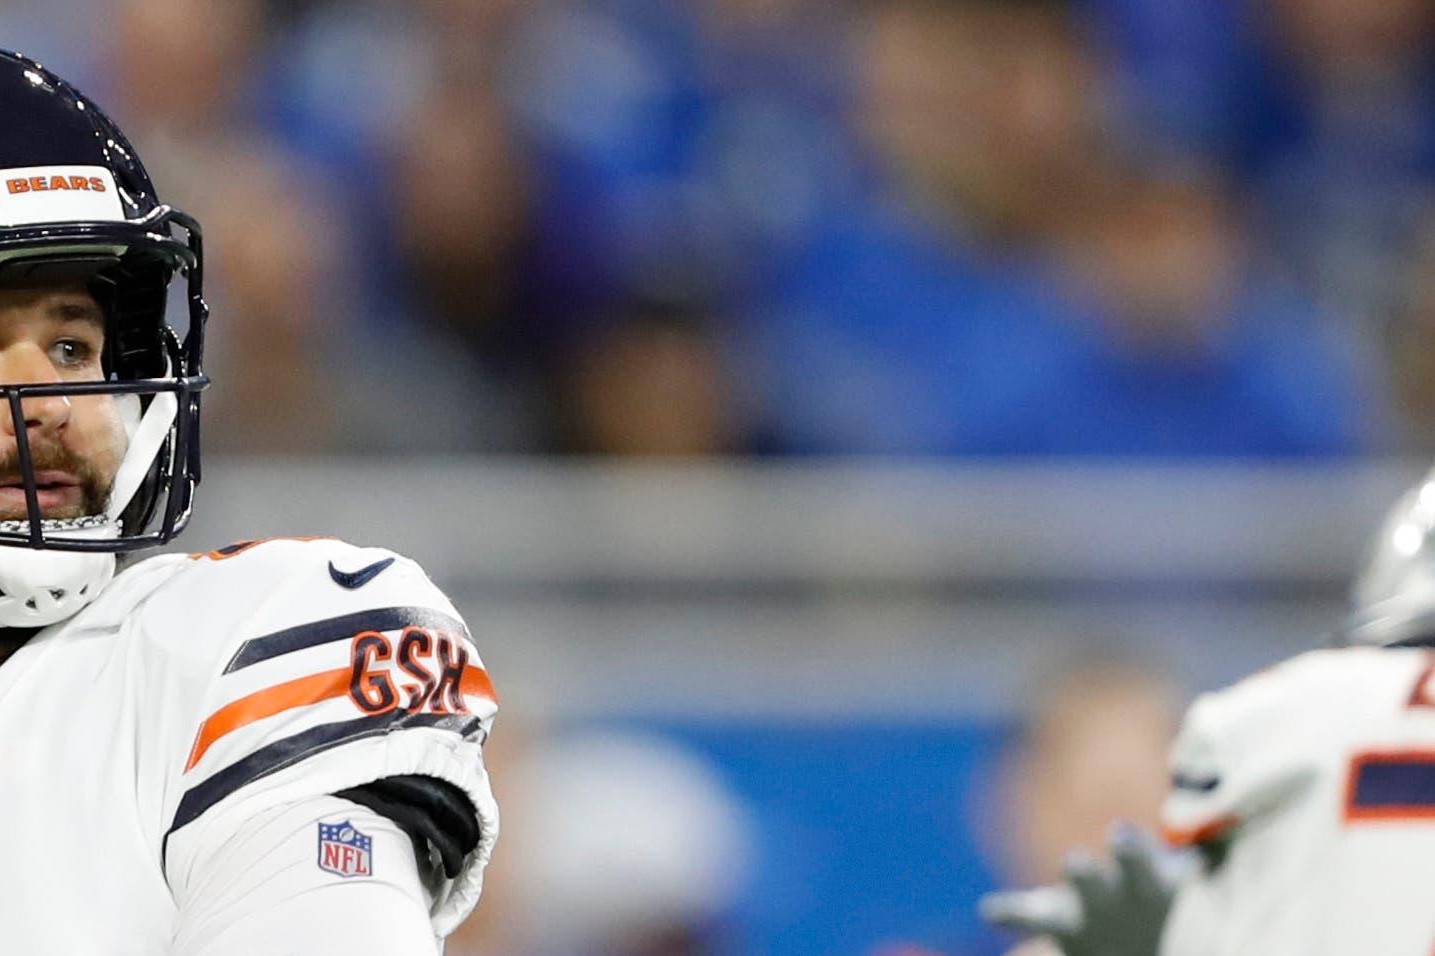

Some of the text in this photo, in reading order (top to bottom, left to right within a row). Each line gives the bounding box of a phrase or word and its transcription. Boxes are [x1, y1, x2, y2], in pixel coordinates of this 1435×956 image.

[6, 175, 106, 194] BEARS
[349, 626, 472, 716] GSH
[323, 842, 367, 874] NFL
